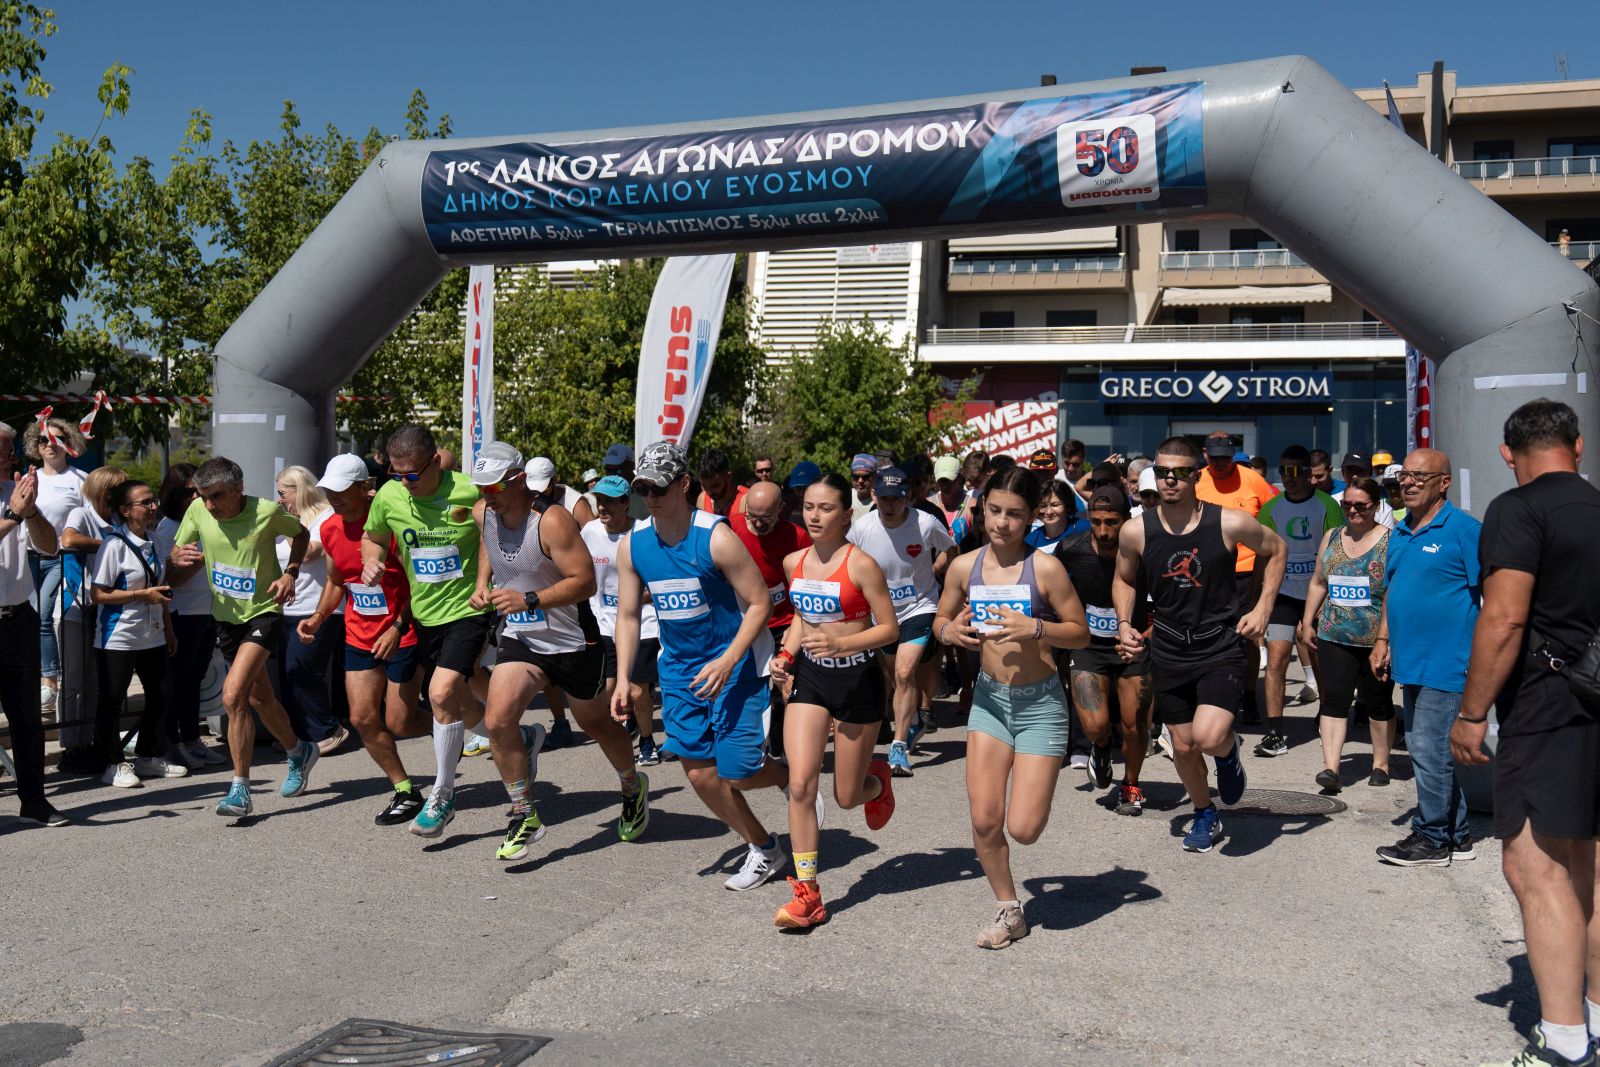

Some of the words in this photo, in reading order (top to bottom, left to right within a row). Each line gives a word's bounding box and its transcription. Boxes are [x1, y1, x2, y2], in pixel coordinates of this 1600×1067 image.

[487, 153, 621, 184] ΛΑΙΚΟΣ
[629, 137, 785, 177] ΑΓΩΝΑΣ
[796, 119, 977, 162] ΔΡΟΜΟΥ
[1075, 126, 1140, 177] 50
[443, 189, 537, 213] ΔΗΜΟΣ
[549, 178, 711, 209] ΚΟΡΔΕΛΙΟΥ
[726, 164, 873, 198] ΕΥΟΣΜΟΥ
[450, 225, 543, 243] ΑΦΕΤΗΡΙΑ
[546, 225, 585, 241] 5χλμ
[601, 215, 745, 237] ΤΕΡΜΑΤΙΣΜΟΣ
[749, 214, 791, 230] 5χλμ
[795, 211, 831, 225] και
[835, 207, 880, 223] 2χλμ
[1100, 377, 1194, 398] GRECO
[1236, 376, 1331, 398] STROM
[417, 557, 457, 574] 5033
[215, 573, 253, 591] 5060
[657, 592, 701, 609] 5095
[889, 586, 913, 599] 004
[1332, 586, 1367, 599] 5030
[792, 594, 837, 613] 5080
[975, 602, 1025, 620] 503
[1089, 615, 1118, 630] 508
